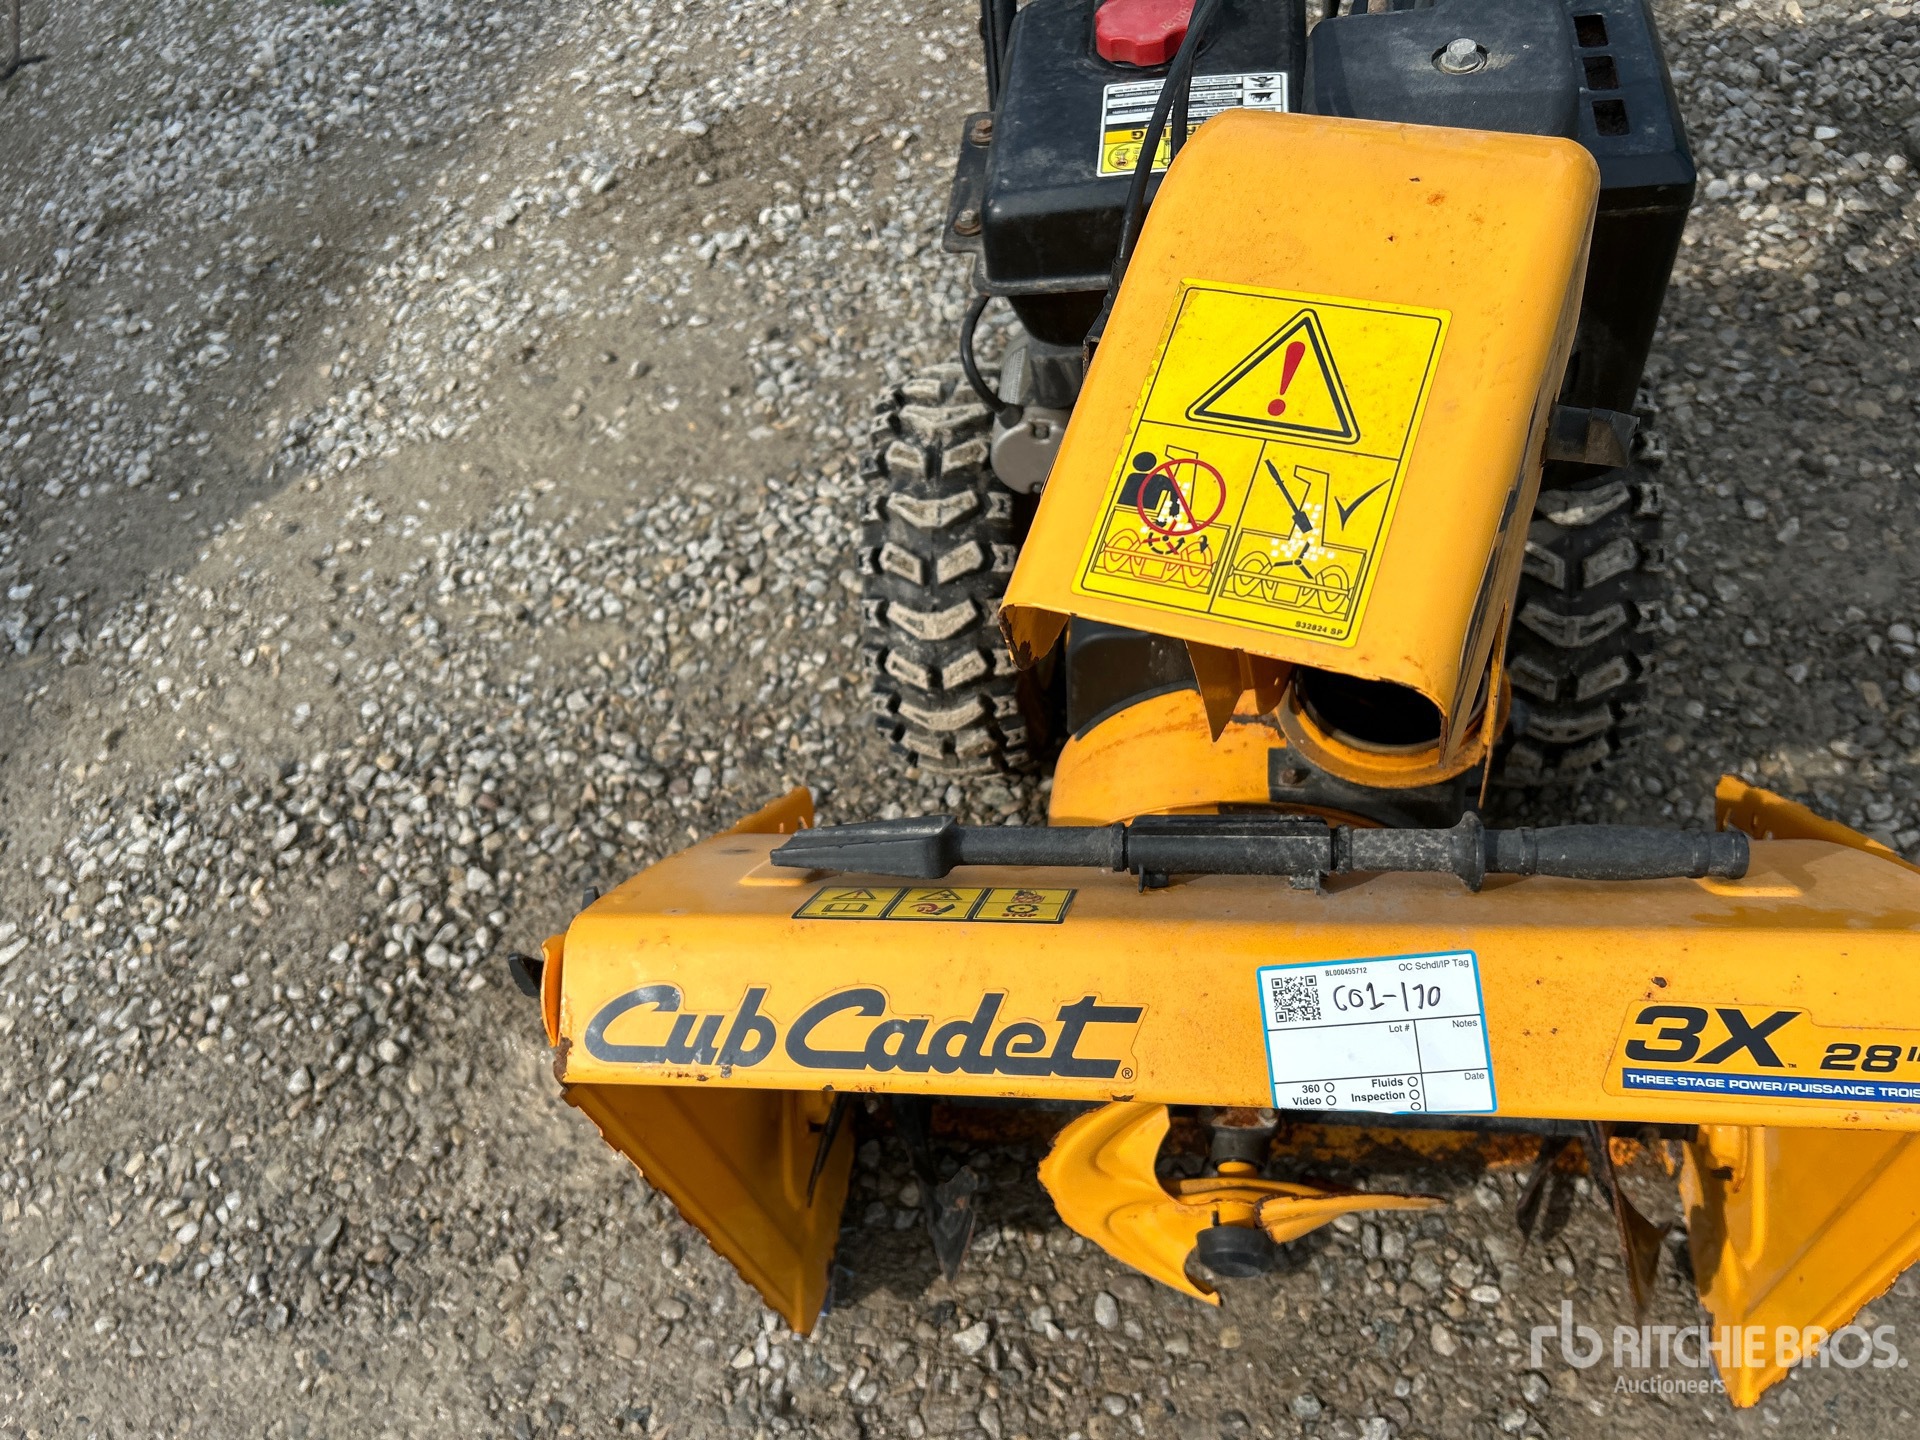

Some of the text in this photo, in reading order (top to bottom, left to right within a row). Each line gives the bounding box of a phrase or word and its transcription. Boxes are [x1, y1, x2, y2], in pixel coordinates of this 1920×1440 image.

[1399, 962, 1413, 972] OC
[1453, 958, 1469, 969] Tag
[1389, 1025, 1403, 1033] Lot
[1452, 1019, 1477, 1028] Notes
[584, 983, 1145, 1079] Cub Cadet
[1625, 1005, 1802, 1068] 3X
[1820, 1043, 1902, 1073] 28
[1464, 1072, 1485, 1081] Date
[1371, 1077, 1403, 1088] Fluids
[1627, 1073, 1726, 1088] THREE-STAGE
[1729, 1079, 1875, 1096] POWER/PUISSANCE
[1302, 1084, 1320, 1094] 360
[1292, 1096, 1321, 1106] Video
[1351, 1090, 1406, 1103] Inspection
